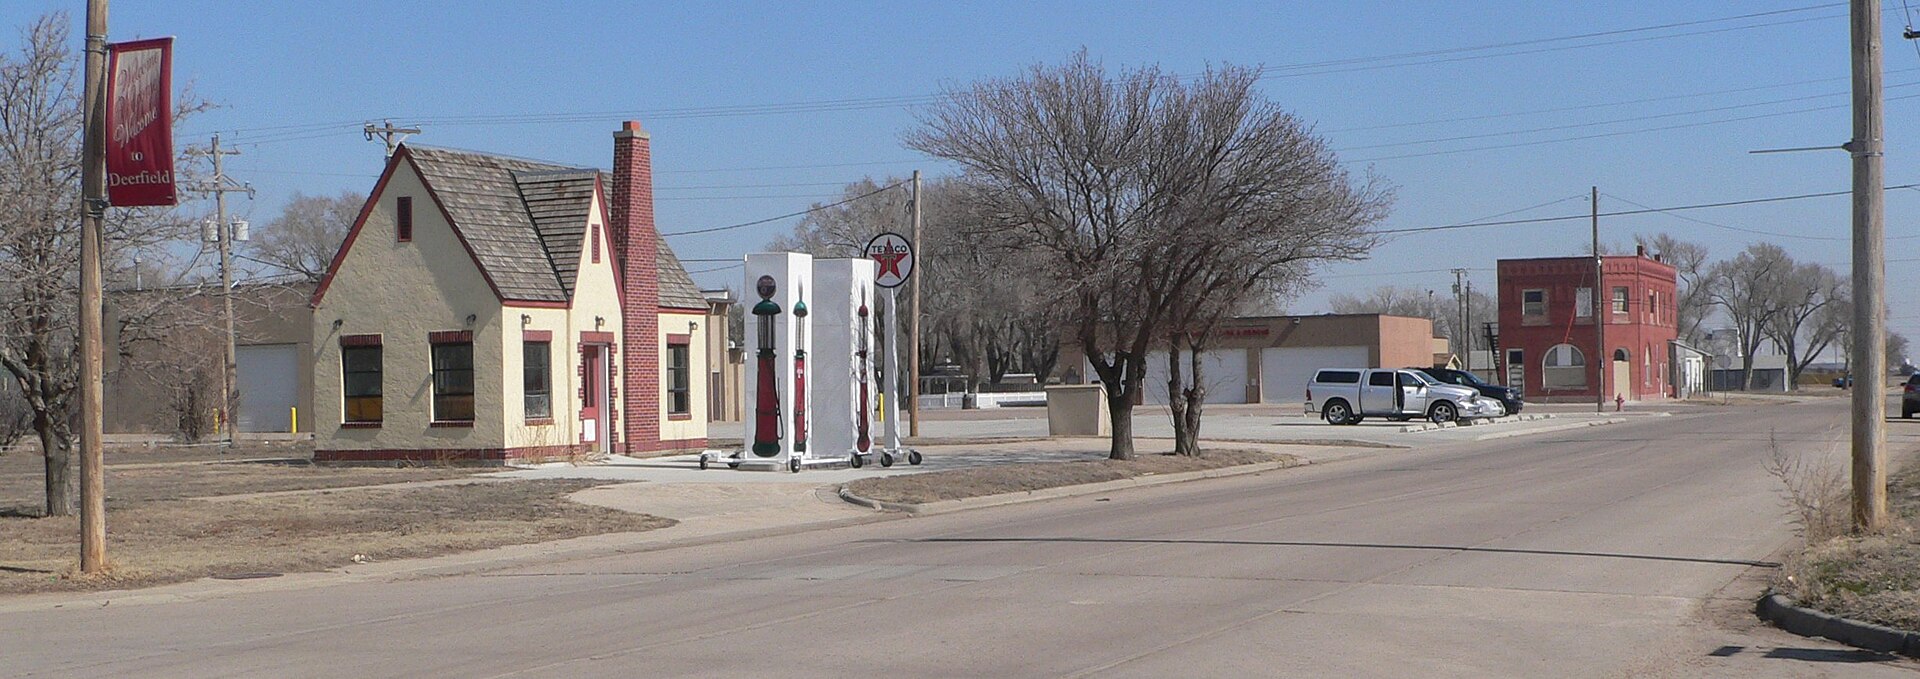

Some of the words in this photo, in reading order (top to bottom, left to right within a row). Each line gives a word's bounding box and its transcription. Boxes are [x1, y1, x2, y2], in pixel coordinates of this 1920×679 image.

[113, 107, 157, 148] Welcome
[131, 151, 143, 162] to
[109, 170, 171, 187] Deerfield
[871, 245, 907, 254] TEXACO
